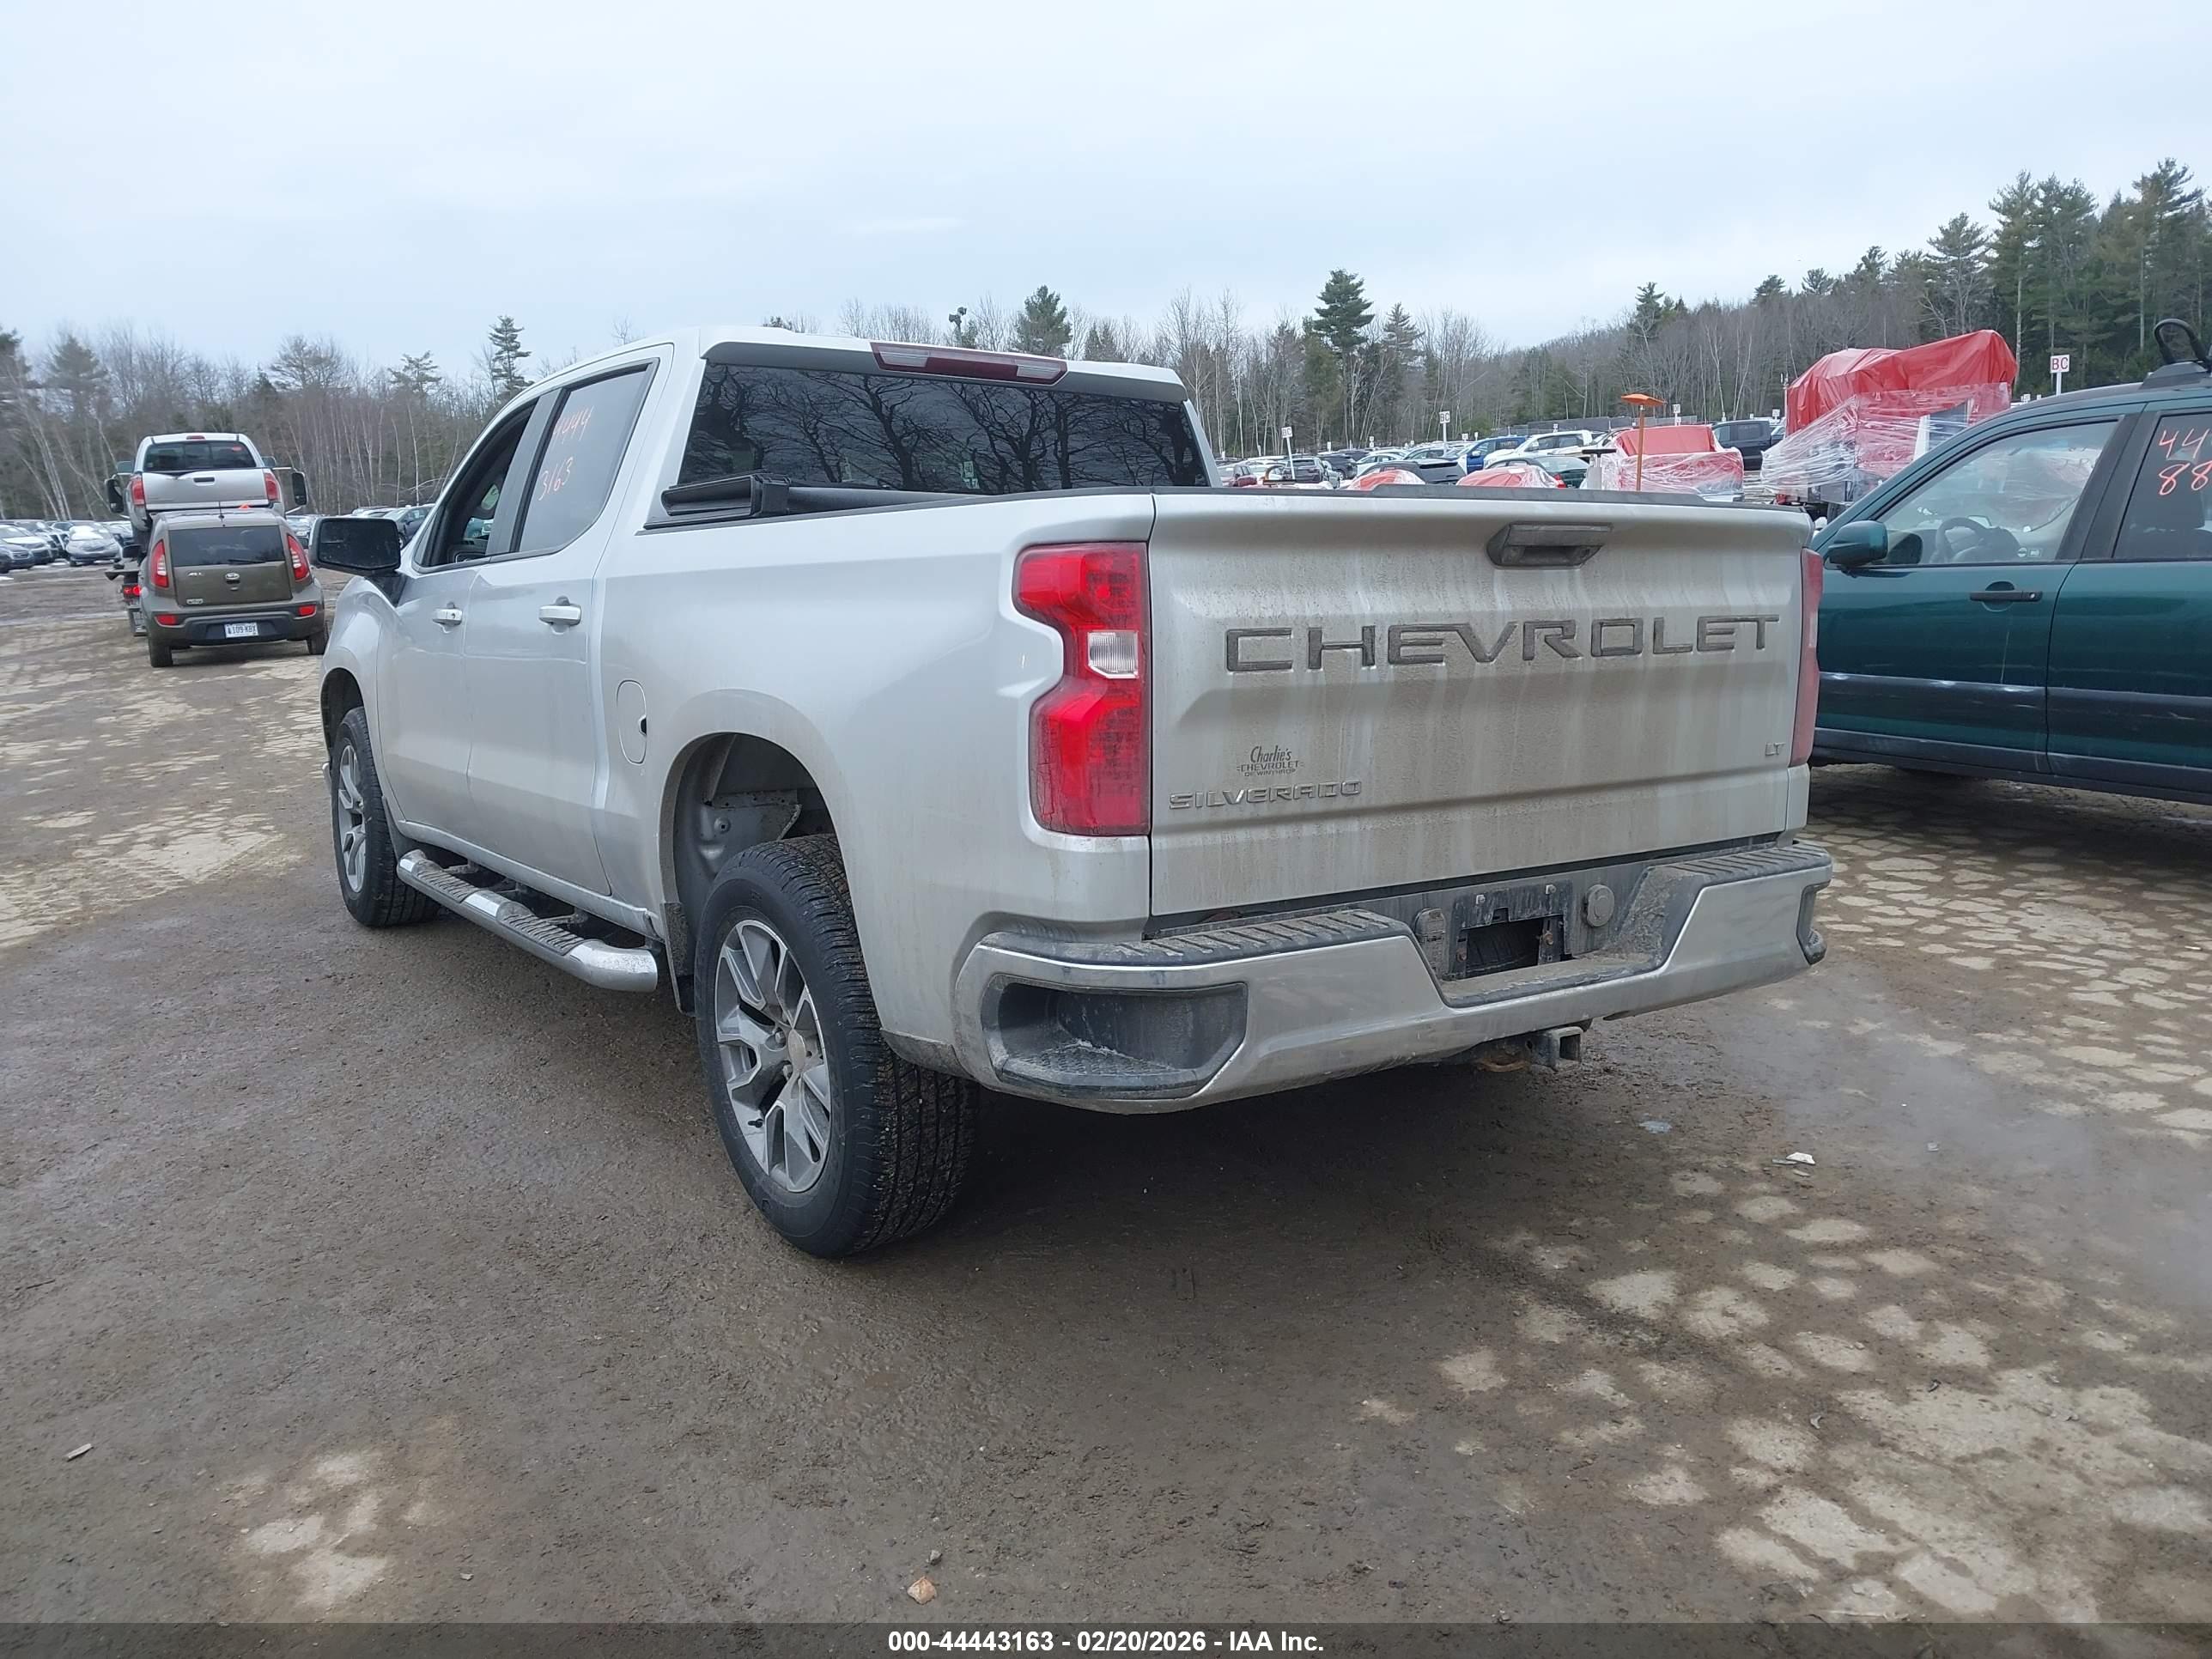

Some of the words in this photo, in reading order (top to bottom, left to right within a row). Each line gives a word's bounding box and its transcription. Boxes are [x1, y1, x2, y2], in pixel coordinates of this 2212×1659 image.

[2051, 357, 2069, 370] BC
[1440, 412, 1450, 422] BC
[538, 456, 574, 501] 3163
[1225, 614, 1780, 672] CHEVROLET
[1250, 744, 1291, 763] Charlie's
[1765, 742, 1786, 757] LT
[1241, 760, 1299, 772] CHEVROLET
[1170, 779, 1362, 810] SILVERADO
